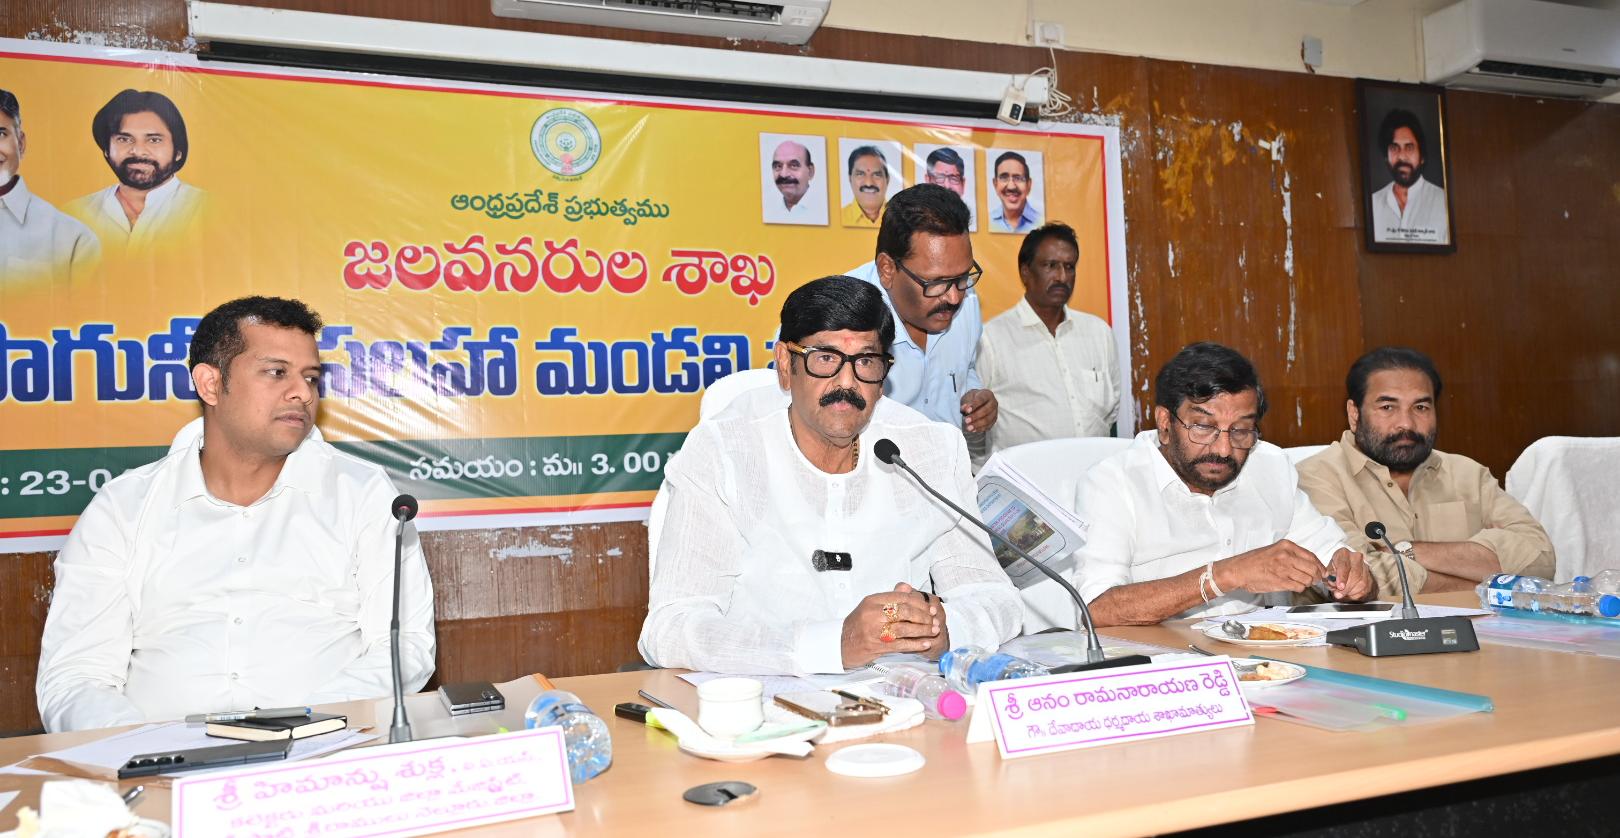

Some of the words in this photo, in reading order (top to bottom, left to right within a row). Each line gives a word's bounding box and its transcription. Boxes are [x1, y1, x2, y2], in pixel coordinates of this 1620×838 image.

[450, 189, 559, 219] ఆంధ్రప్రదేశ్
[563, 196, 669, 225] ప్రభుత్వము
[343, 234, 648, 294] జలవనరుల
[661, 249, 776, 306] శాఖ
[535, 327, 750, 396] మండలి
[20, 467, 128, 497] 23-0
[410, 453, 524, 481] సమయం
[591, 453, 615, 475] 3.
[623, 451, 661, 474] 00
[1005, 692, 1024, 720] శ్రీ
[1027, 693, 1070, 712] ఆనం
[1073, 676, 1199, 706] రామనారాయణ
[1199, 669, 1231, 697] రెడ్డి
[1047, 720, 1102, 736] దేవాదాయ
[1152, 703, 1223, 723] శాఖామాత్యులు
[212, 777, 243, 811] శ్రీ
[253, 767, 389, 800] హిమాన్షు
